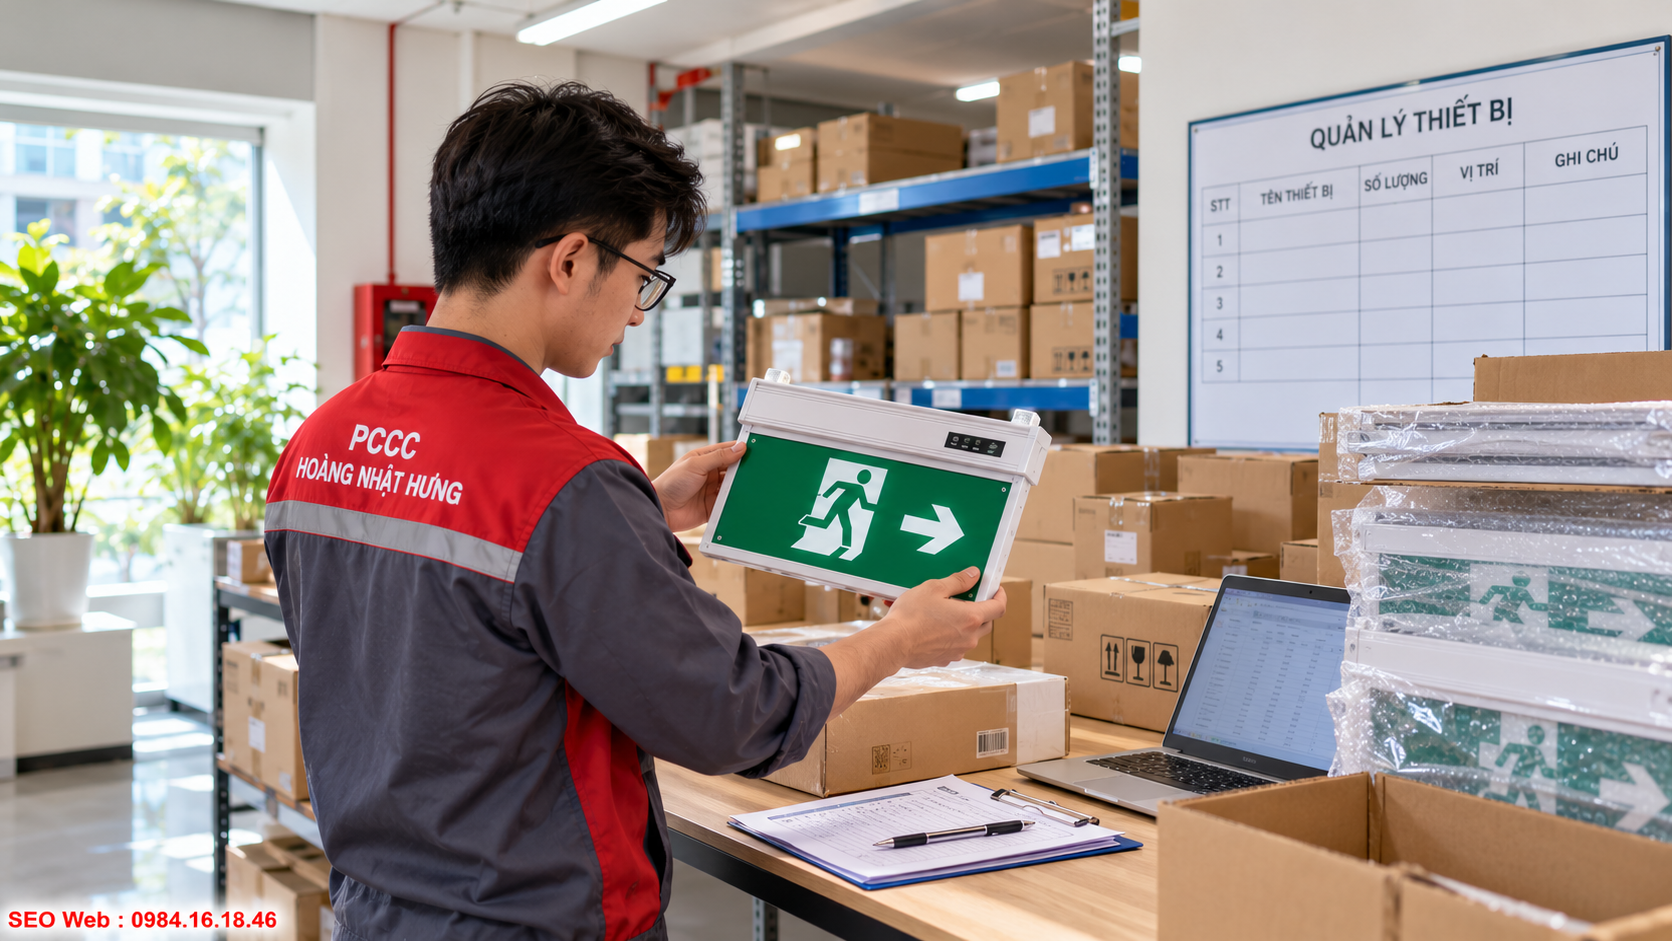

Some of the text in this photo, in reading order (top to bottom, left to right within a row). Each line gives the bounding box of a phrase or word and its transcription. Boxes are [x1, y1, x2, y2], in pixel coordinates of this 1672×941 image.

[1310, 94, 1513, 151] QUẢN LÝ THIẾT BỊ
[1555, 142, 1619, 167] GHI CHÚ
[1460, 158, 1499, 182] VỊ TRÍ
[1385, 171, 1428, 190] LƯỢNG
[1285, 181, 1318, 202] THIẾT
[1321, 184, 1334, 200] BỊ
[1210, 198, 1231, 212] STT
[1216, 233, 1223, 247] 1
[1216, 265, 1224, 279] 2
[1216, 296, 1224, 310] 3
[1216, 327, 1224, 341] 4
[1216, 359, 1224, 373] 5
[348, 424, 421, 459] PCCC
[296, 453, 354, 485] HOÀNG
[356, 464, 405, 497] NHẬT
